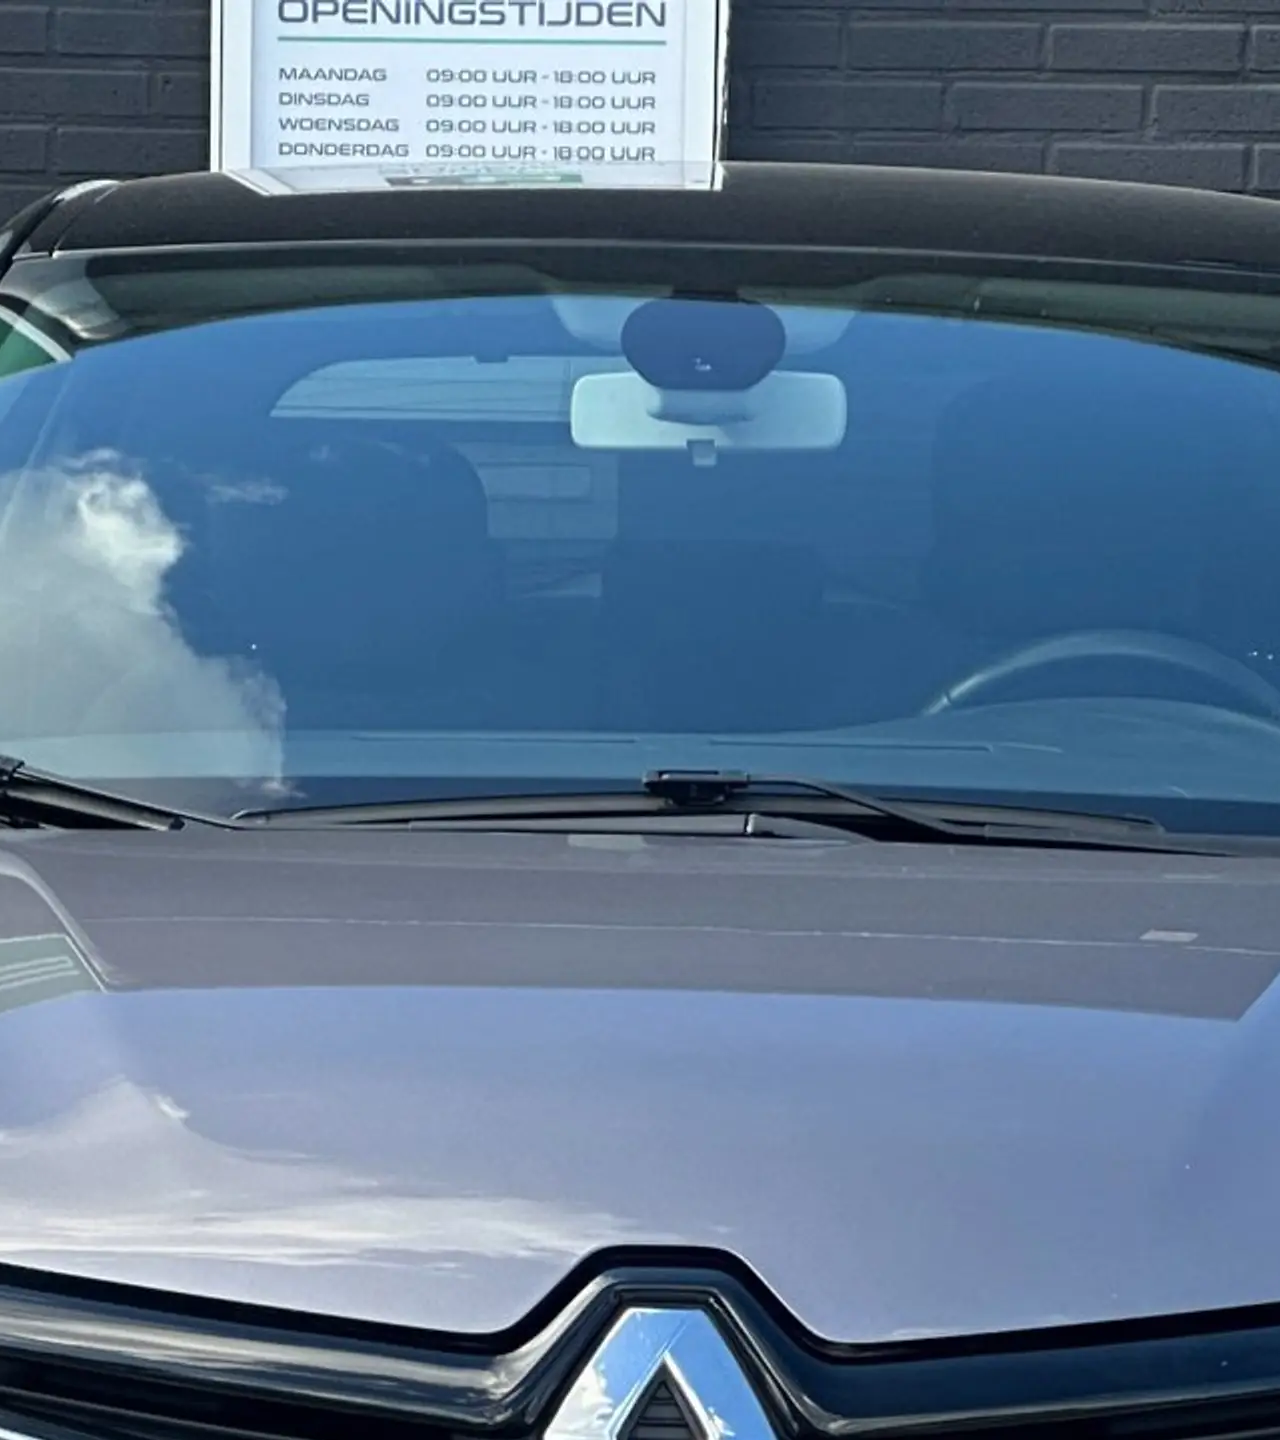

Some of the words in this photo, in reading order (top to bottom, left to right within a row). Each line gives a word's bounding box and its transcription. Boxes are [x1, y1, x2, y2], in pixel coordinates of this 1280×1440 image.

[278, 0, 666, 27] OPENINGSTIJDEN
[278, 67, 387, 81] MAANDAG
[492, 69, 537, 83] UUR
[611, 70, 656, 84] UUR
[278, 92, 370, 106] DINSDAG
[492, 94, 537, 109] UUR
[611, 95, 656, 110] UUR
[278, 117, 400, 132] WOENSDAG
[492, 119, 537, 134] UUR
[611, 120, 656, 135] UUR
[278, 142, 410, 157] DONDERDAG
[492, 144, 537, 159] UUR
[611, 145, 656, 161] UUR
